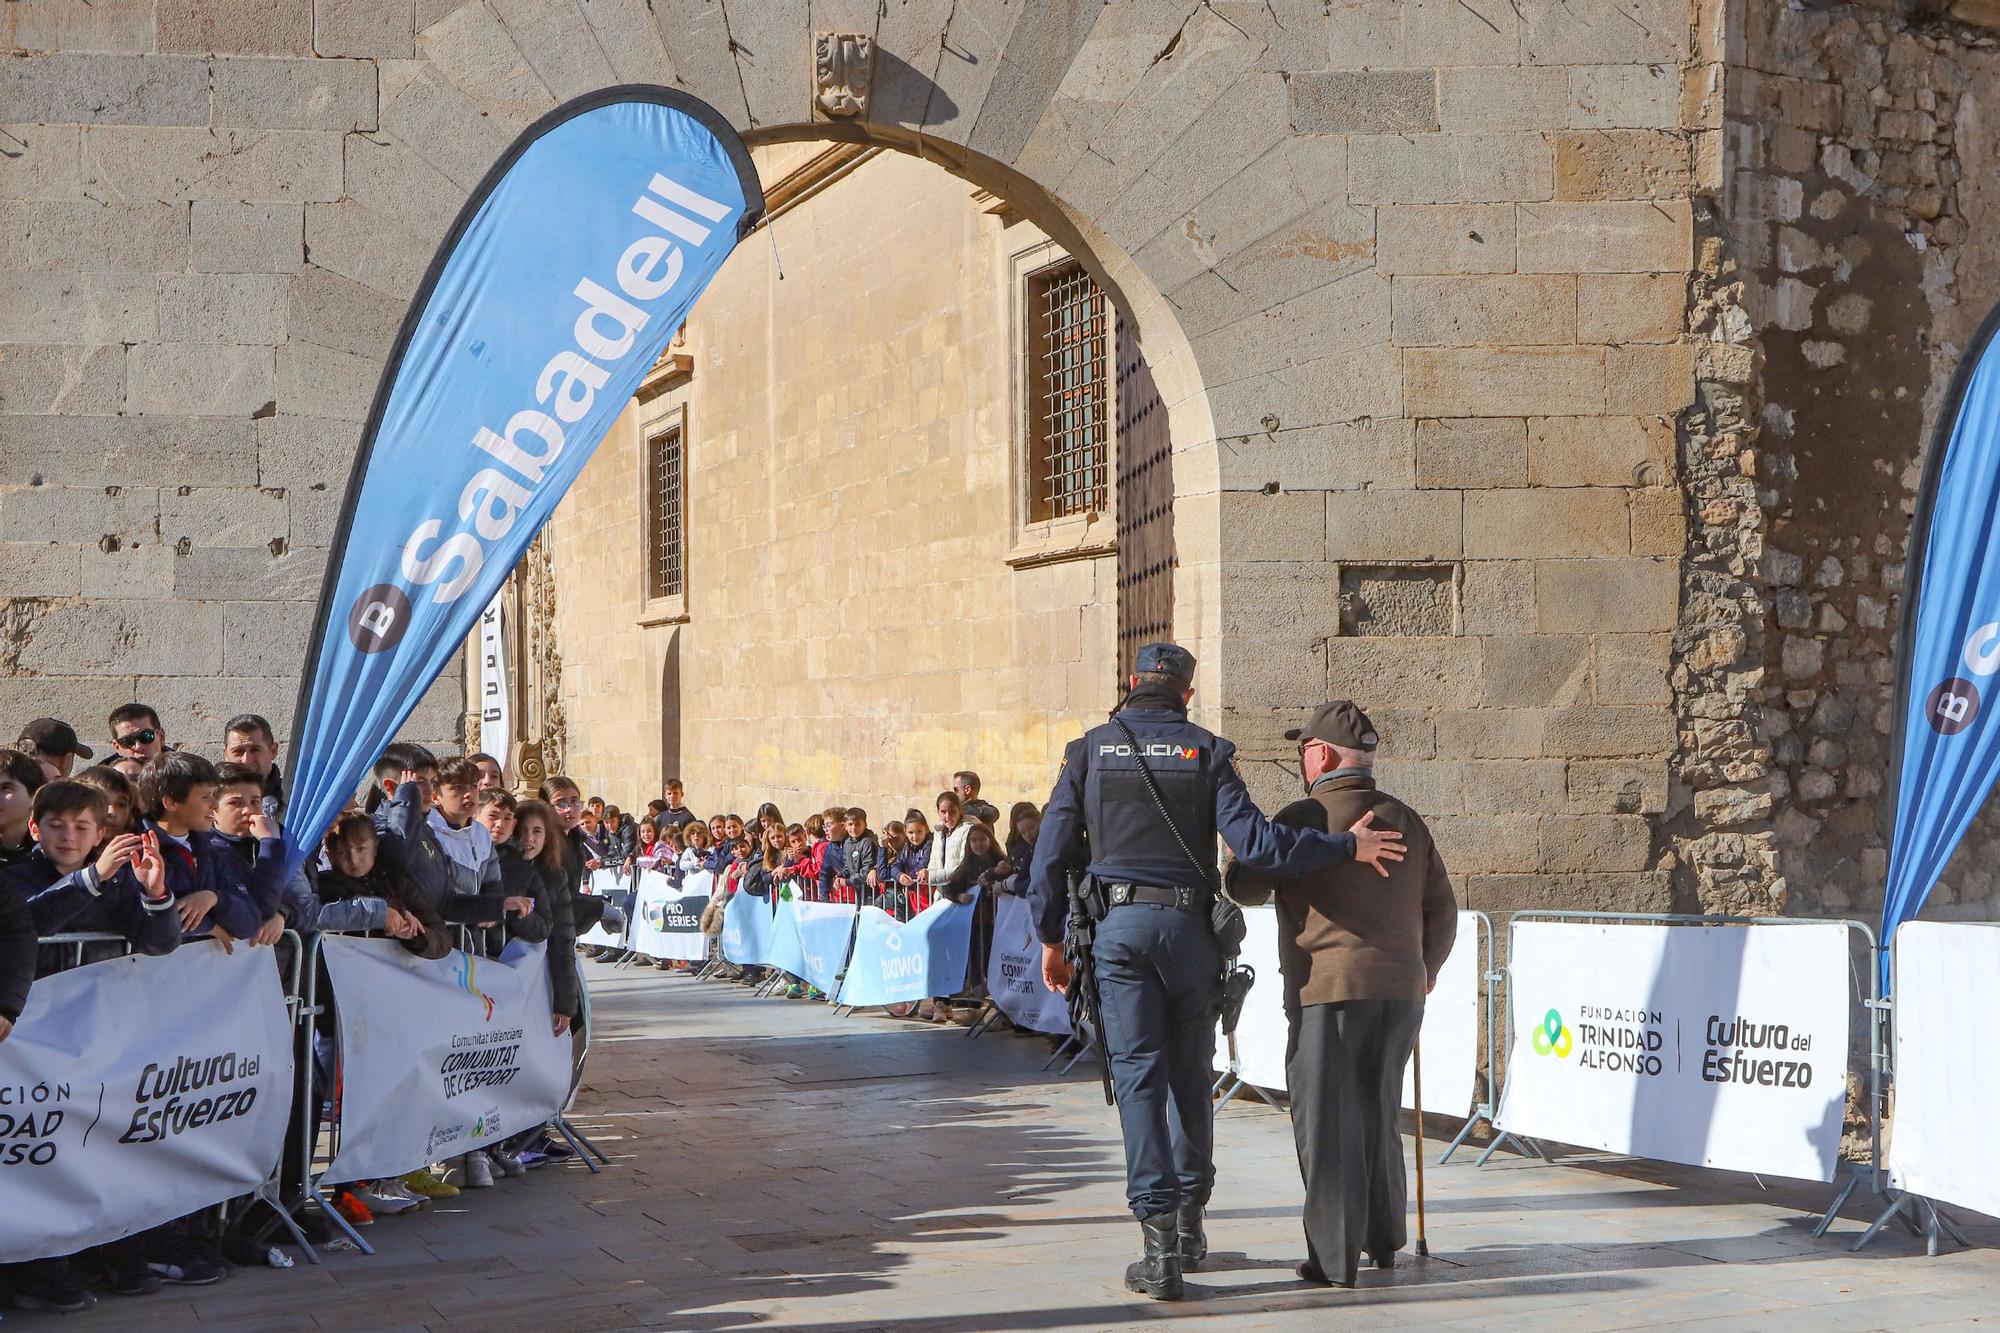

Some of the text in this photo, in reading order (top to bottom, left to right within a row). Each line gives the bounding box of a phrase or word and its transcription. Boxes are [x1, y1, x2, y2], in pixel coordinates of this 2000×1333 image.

[359, 172, 733, 638] B Sabadell
[1936, 692, 1969, 722] B
[666, 903, 684, 915] PRO
[667, 915, 699, 927] SERIES
[1580, 1005, 1662, 1025] FUNDACIÓN
[452, 1028, 523, 1048] Comunitat Valenciana
[1579, 1024, 1663, 1052] TRINIDAD
[1706, 1015, 1811, 1051] Cultura del
[441, 1044, 520, 1074] COMUNITAT
[1579, 1048, 1662, 1076] ALFONSO
[1702, 1049, 1812, 1089] Esfuerzo
[136, 1052, 260, 1103] Cultura del
[443, 1074, 457, 1100] DE
[118, 1087, 257, 1144] Esfuerzo
